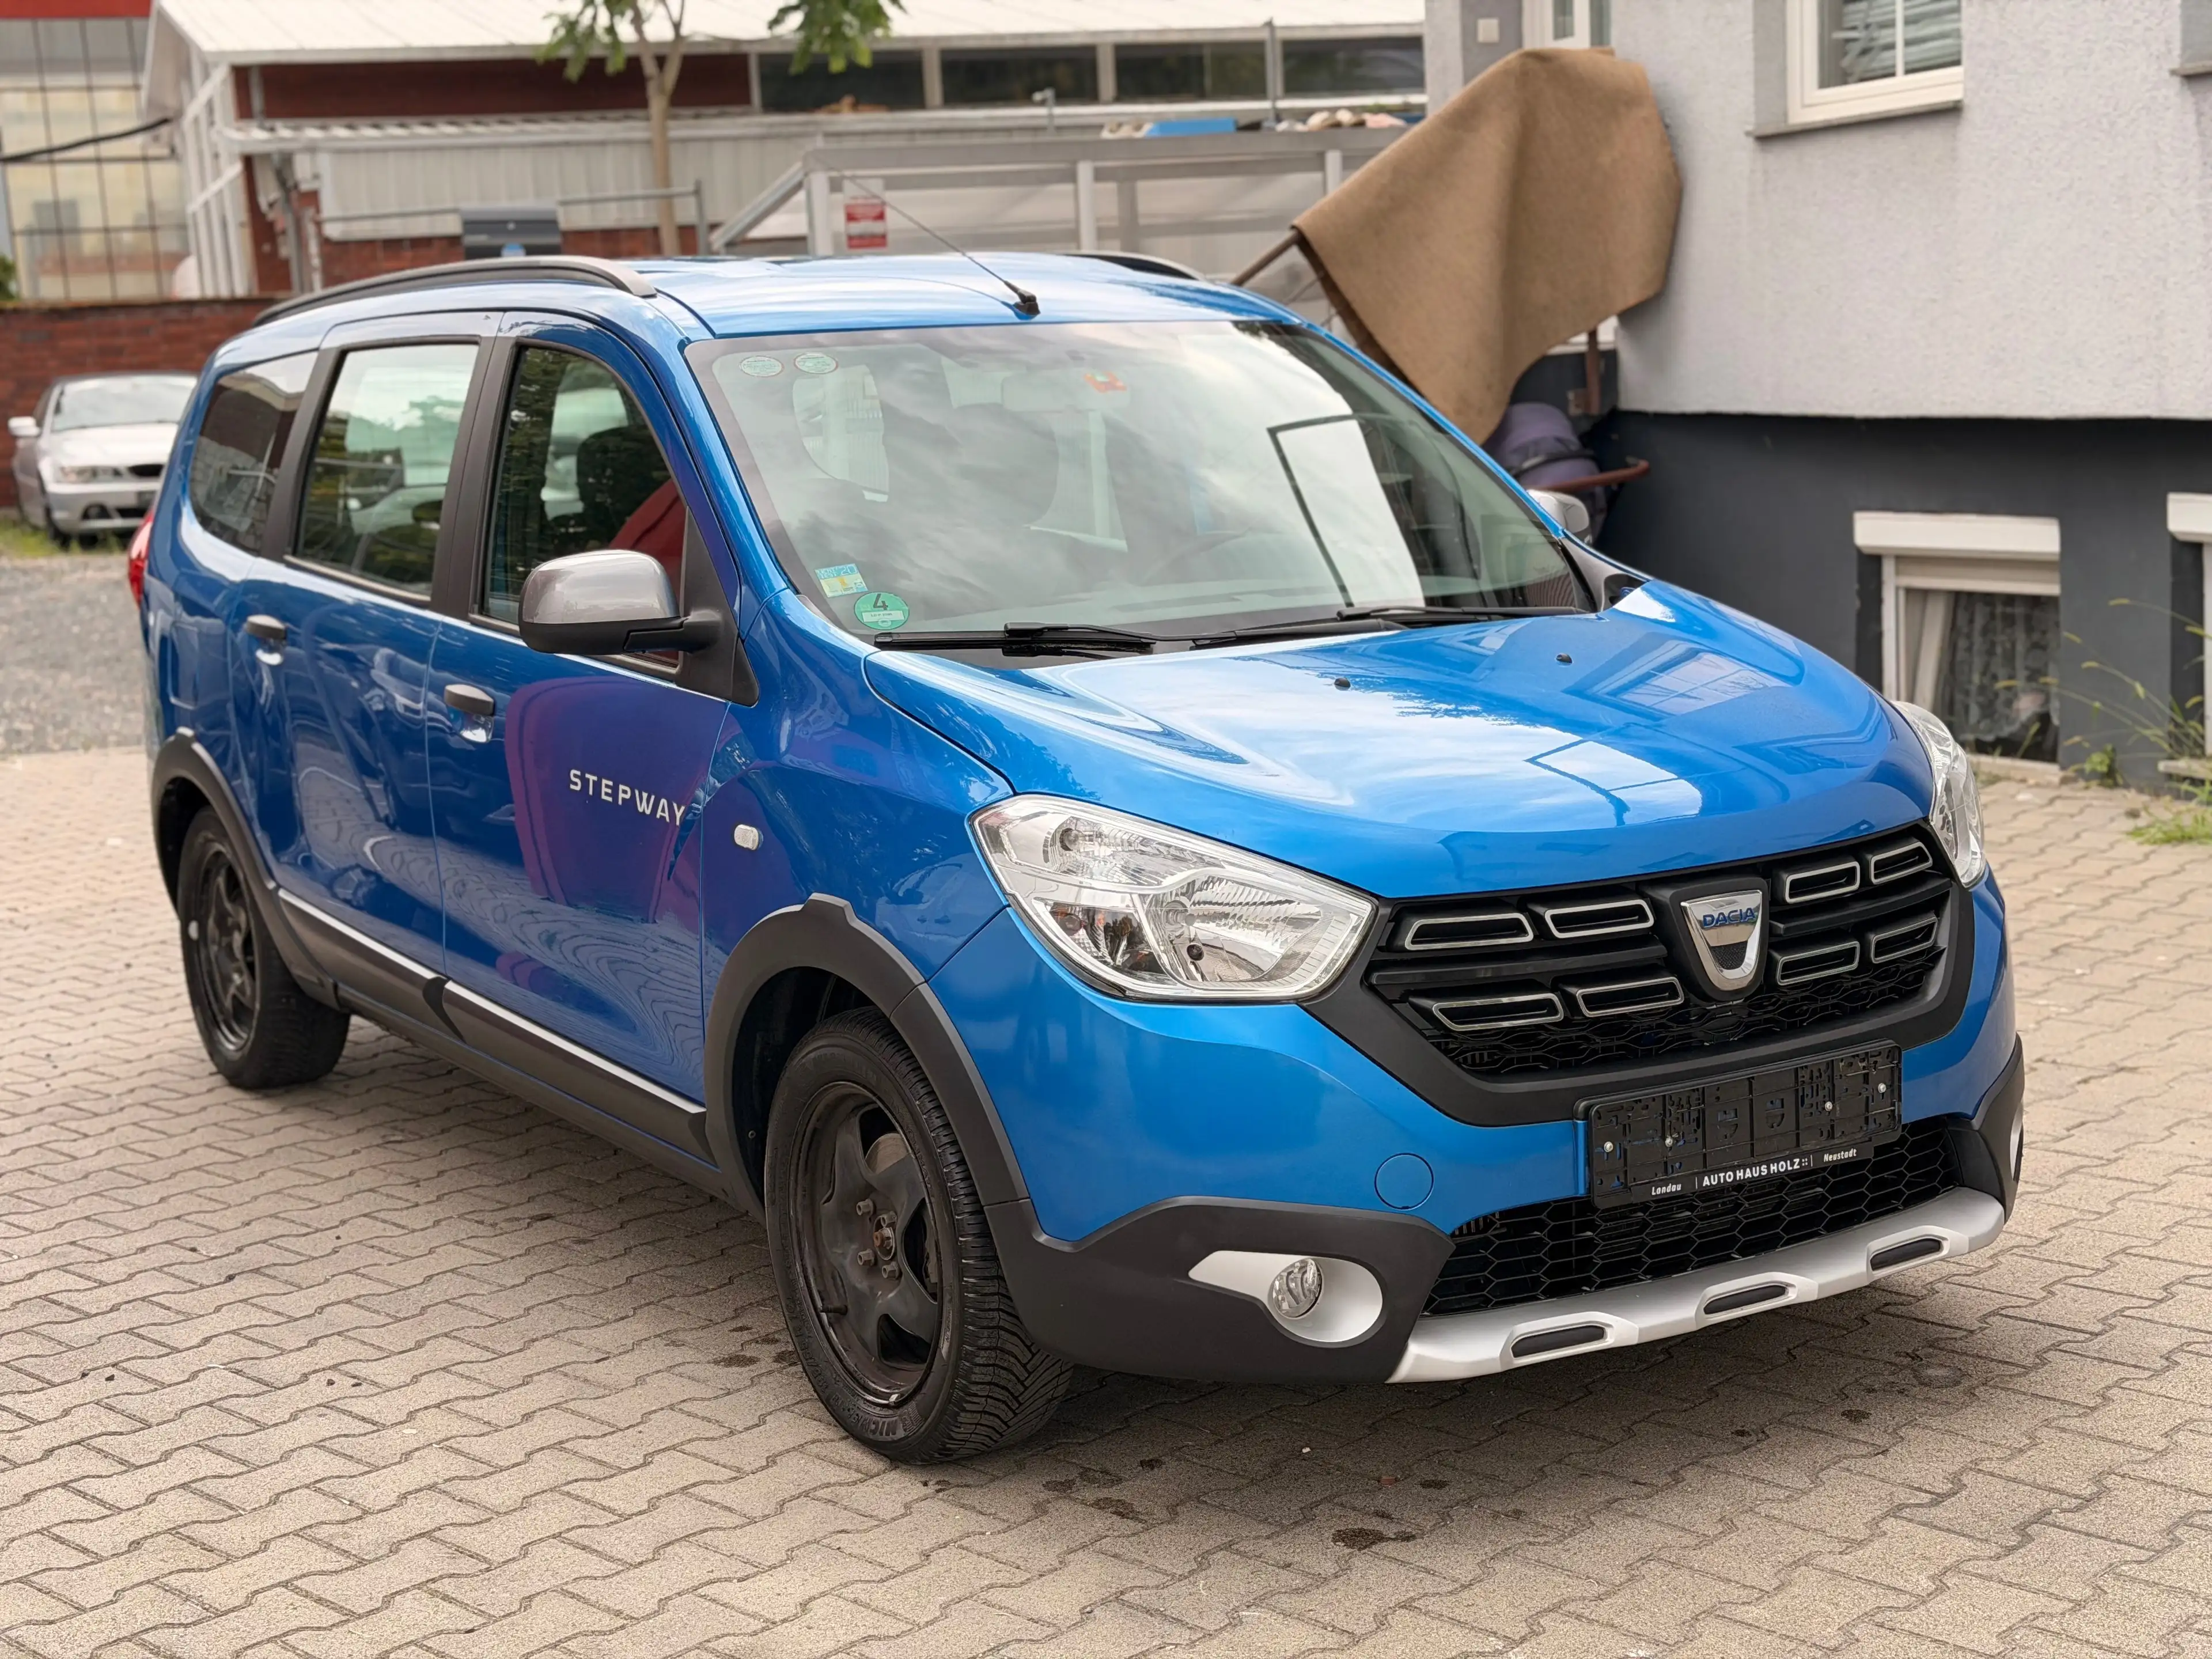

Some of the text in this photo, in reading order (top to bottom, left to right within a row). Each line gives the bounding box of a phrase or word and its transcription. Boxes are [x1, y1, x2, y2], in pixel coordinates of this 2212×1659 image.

[873, 593, 888, 610] 4
[569, 768, 685, 826] STEPWAY
[1703, 907, 1756, 927] DACIA
[1651, 1183, 1681, 1195] Landau
[1770, 1158, 1800, 1174] HOLZ
[1823, 1148, 1857, 1162] Neustadt
